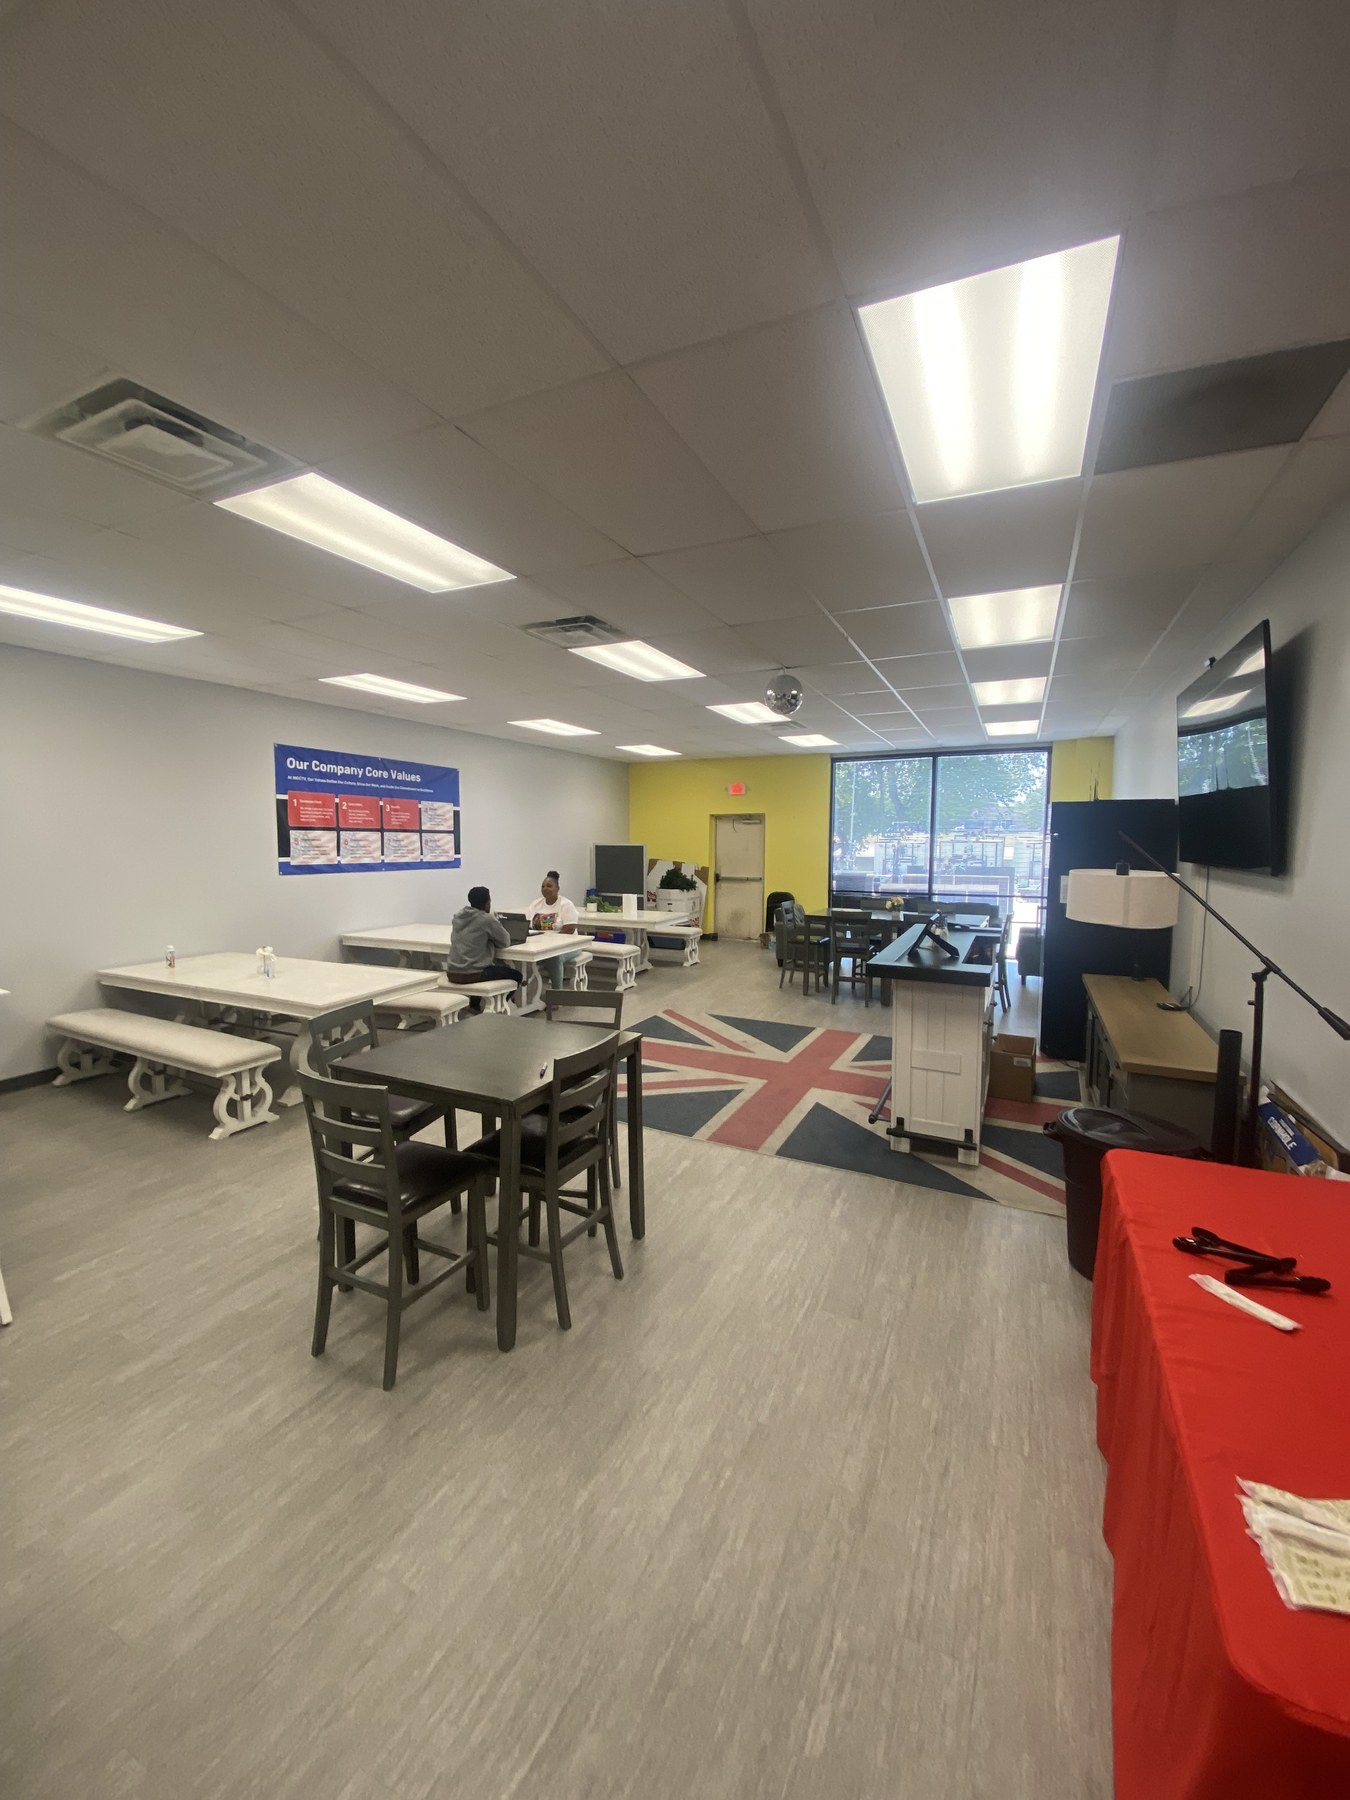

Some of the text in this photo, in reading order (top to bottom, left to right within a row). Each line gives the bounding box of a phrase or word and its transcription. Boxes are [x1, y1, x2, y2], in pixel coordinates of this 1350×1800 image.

[286, 757, 421, 782] Our Company Core Values
[293, 799, 297, 807] 1
[342, 801, 347, 810] 2
[385, 804, 390, 812] 3
